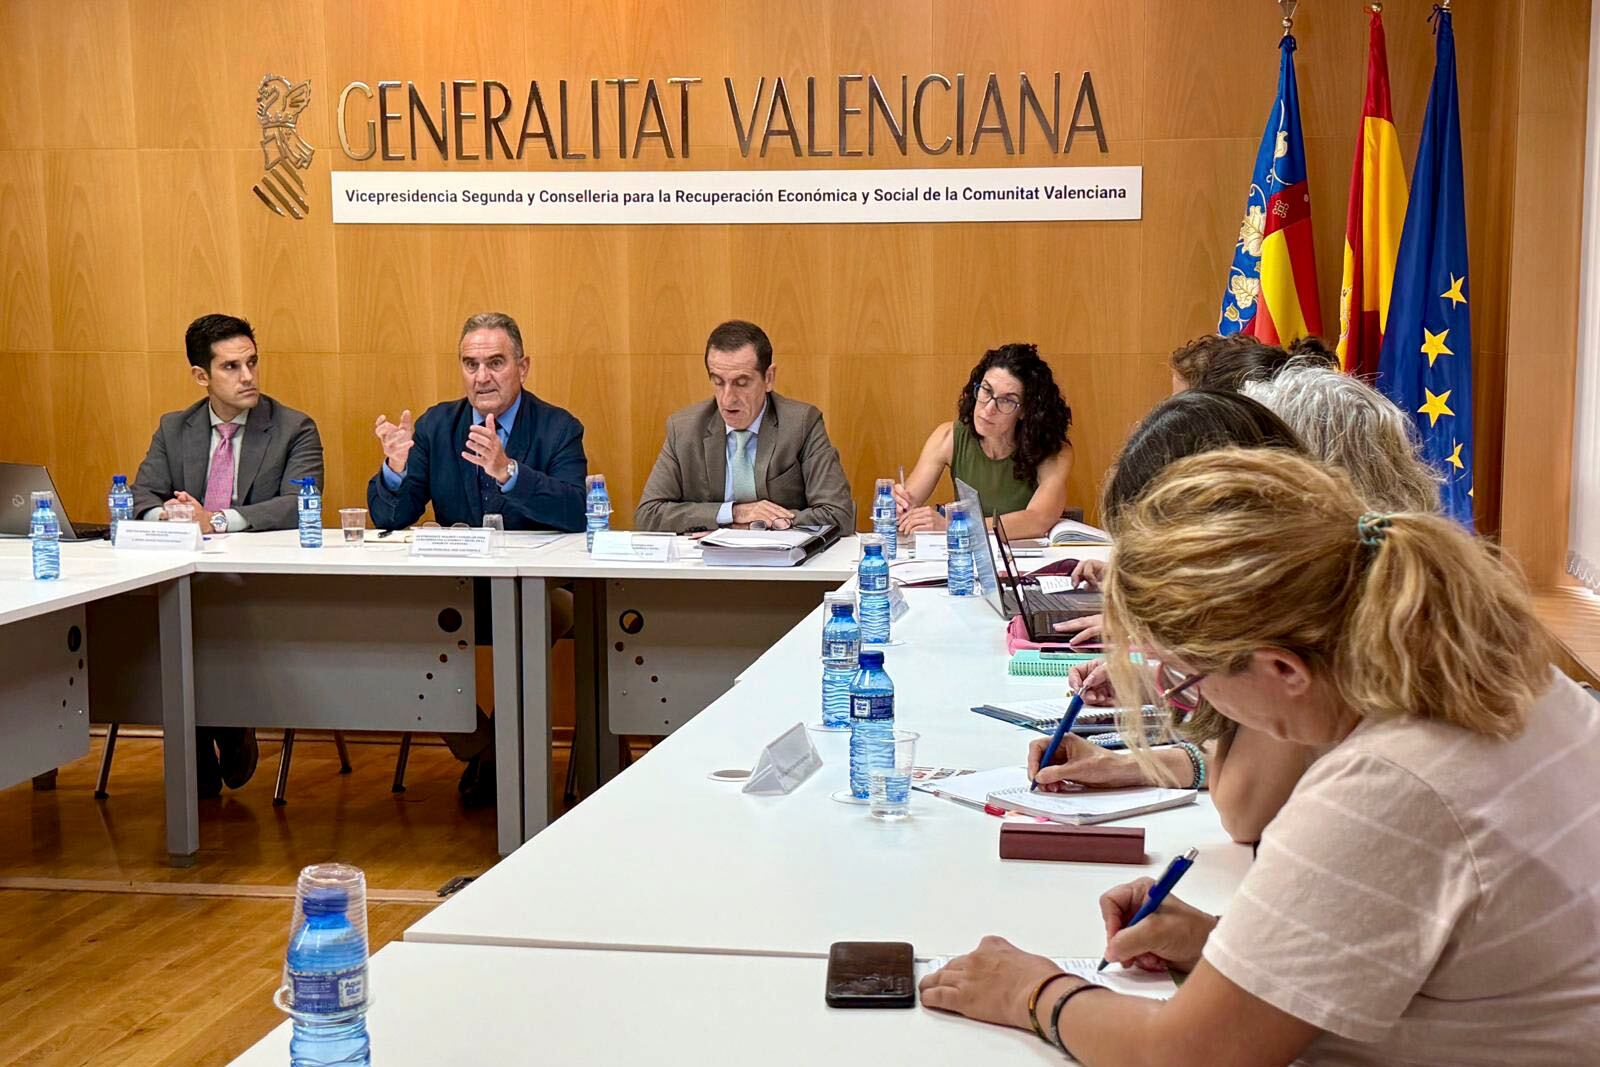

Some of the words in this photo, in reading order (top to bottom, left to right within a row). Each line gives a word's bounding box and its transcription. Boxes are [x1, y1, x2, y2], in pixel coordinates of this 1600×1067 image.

[336, 77, 702, 162] GENERALITAT
[723, 71, 1109, 158] VALENCIANA
[345, 189, 458, 206] Vicepresidencia
[461, 189, 524, 206] Segunda
[527, 192, 536, 206] y
[539, 189, 619, 203] Conselleria
[623, 192, 655, 206] para
[658, 189, 671, 203] la
[675, 188, 774, 206] Recuperación
[778, 188, 857, 203] Económica
[861, 191, 870, 206] y
[874, 186, 919, 202] Social
[922, 186, 941, 201] de
[945, 186, 958, 201] la
[962, 185, 1040, 201] Comunitat
[1043, 184, 1127, 200] Valenciana
